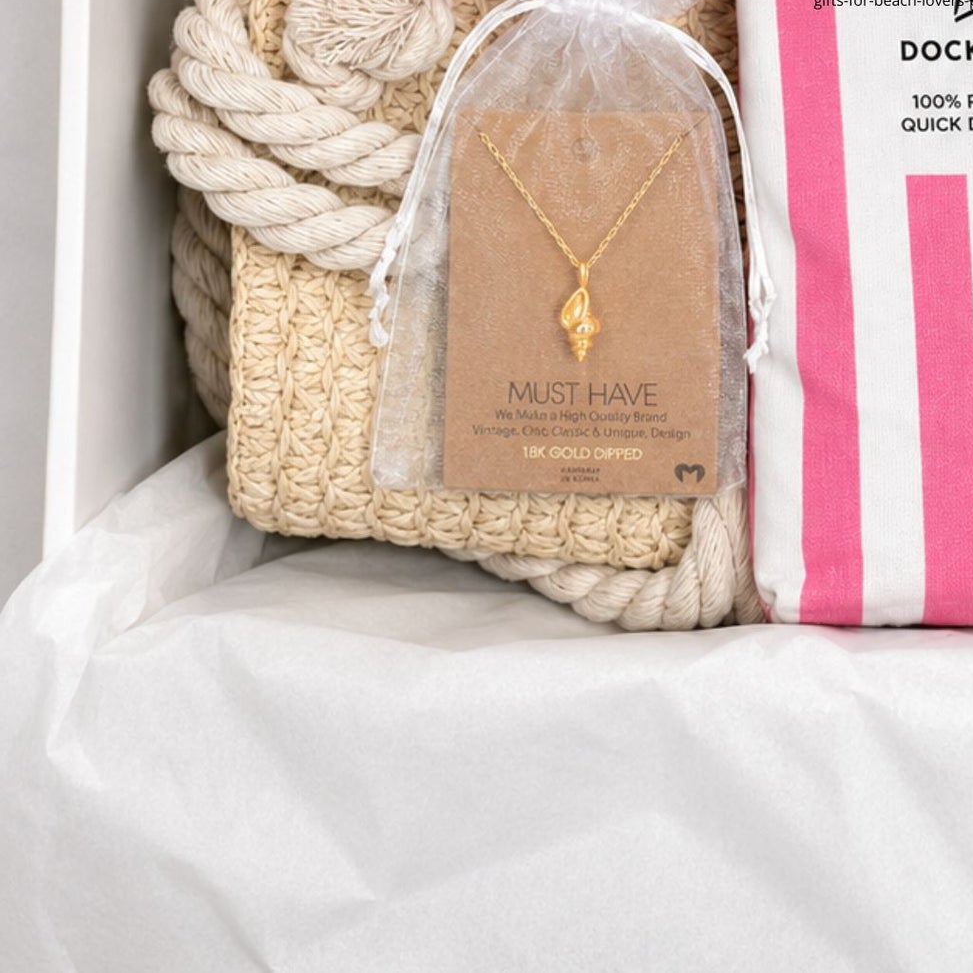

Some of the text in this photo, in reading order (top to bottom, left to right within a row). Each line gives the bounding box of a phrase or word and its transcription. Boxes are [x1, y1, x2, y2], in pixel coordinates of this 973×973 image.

[912, 94, 961, 109] 100%
[901, 116, 961, 133] QUICK
[508, 381, 658, 406] MUST HAVE
[592, 427, 600, 438] &
[523, 446, 643, 460] 18K GOLD DIPPED
